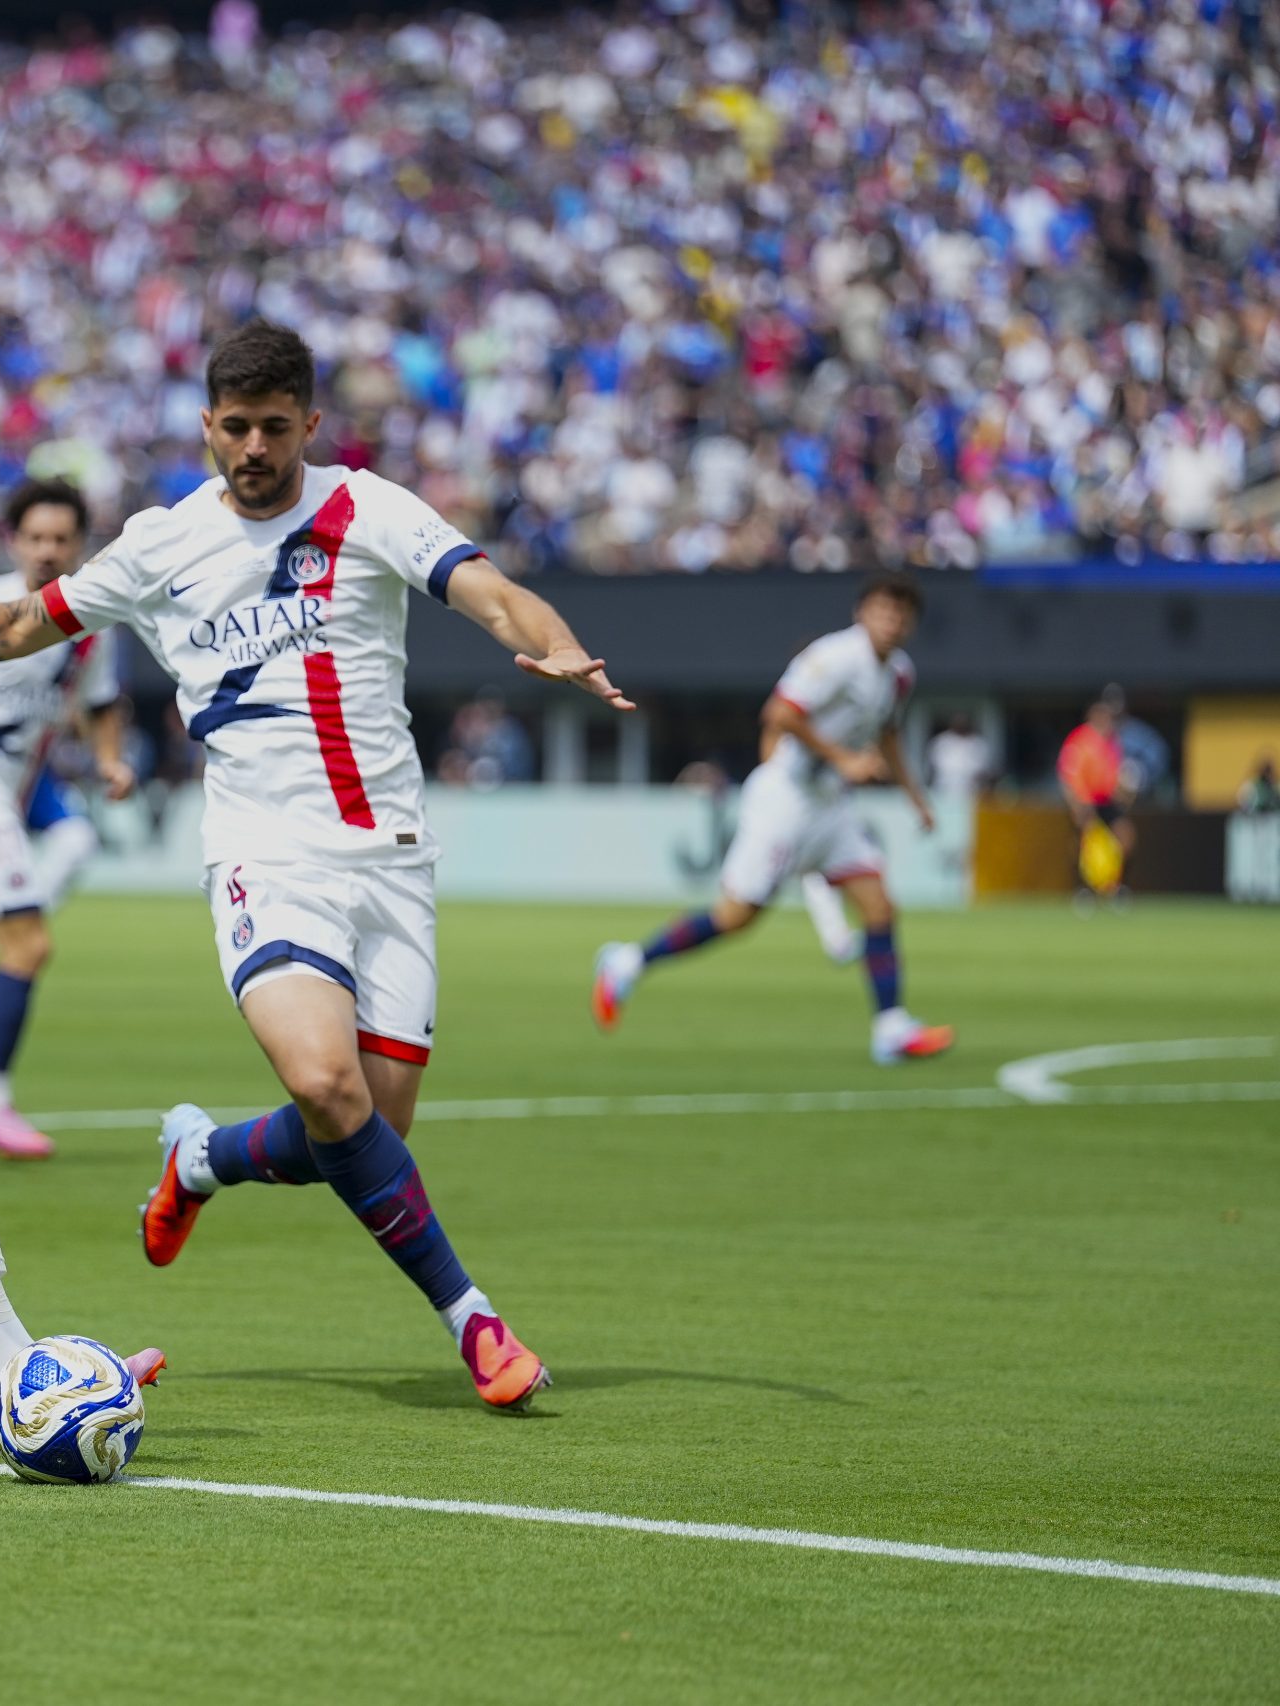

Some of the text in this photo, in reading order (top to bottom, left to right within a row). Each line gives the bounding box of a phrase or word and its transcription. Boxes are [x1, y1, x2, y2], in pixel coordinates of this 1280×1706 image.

[190, 598, 325, 653] QATAR
[227, 631, 327, 663] AIRWAYS
[227, 865, 247, 909] 4
